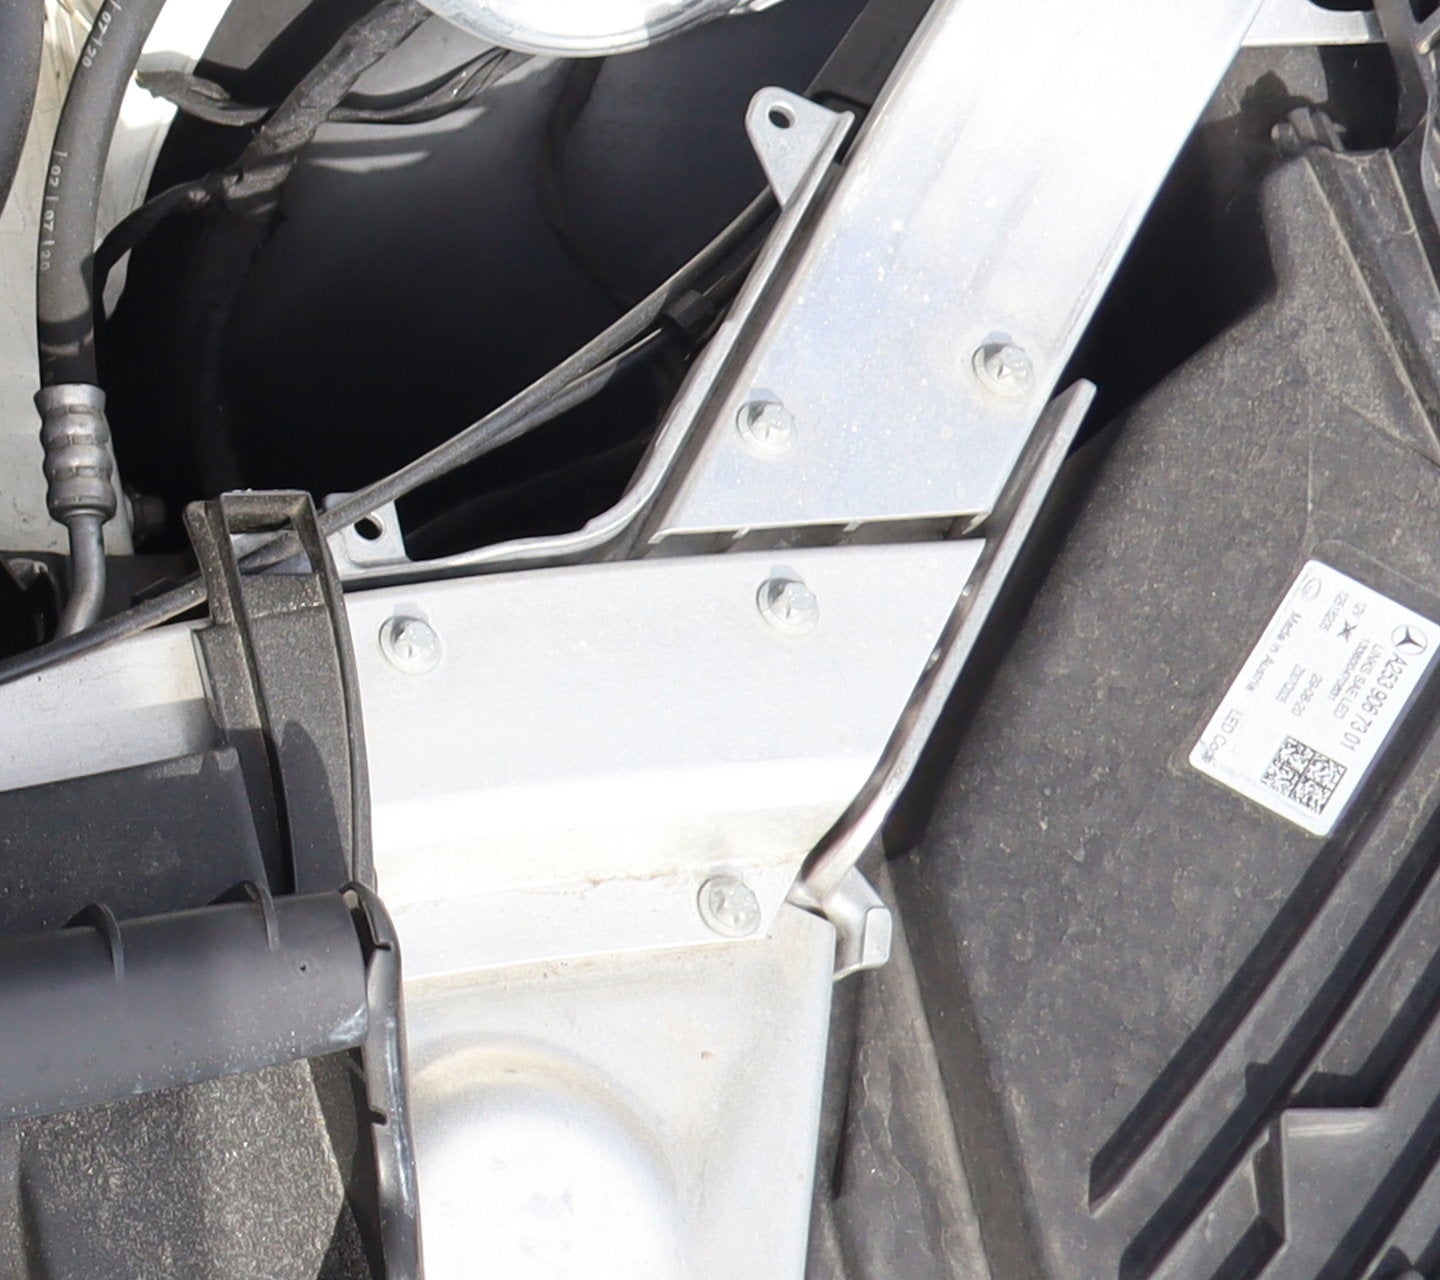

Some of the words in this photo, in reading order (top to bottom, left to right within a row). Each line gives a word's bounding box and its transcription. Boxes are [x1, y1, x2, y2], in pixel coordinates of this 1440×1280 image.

[1275, 609, 1302, 643] Made
[1244, 653, 1275, 694] Austria
[1345, 673, 1367, 698] SAE
[1374, 650, 1409, 691] A253
[1358, 685, 1388, 717] 906
[1219, 707, 1244, 735] LED
[1347, 712, 1372, 736] 73
[1338, 731, 1361, 752] 01
